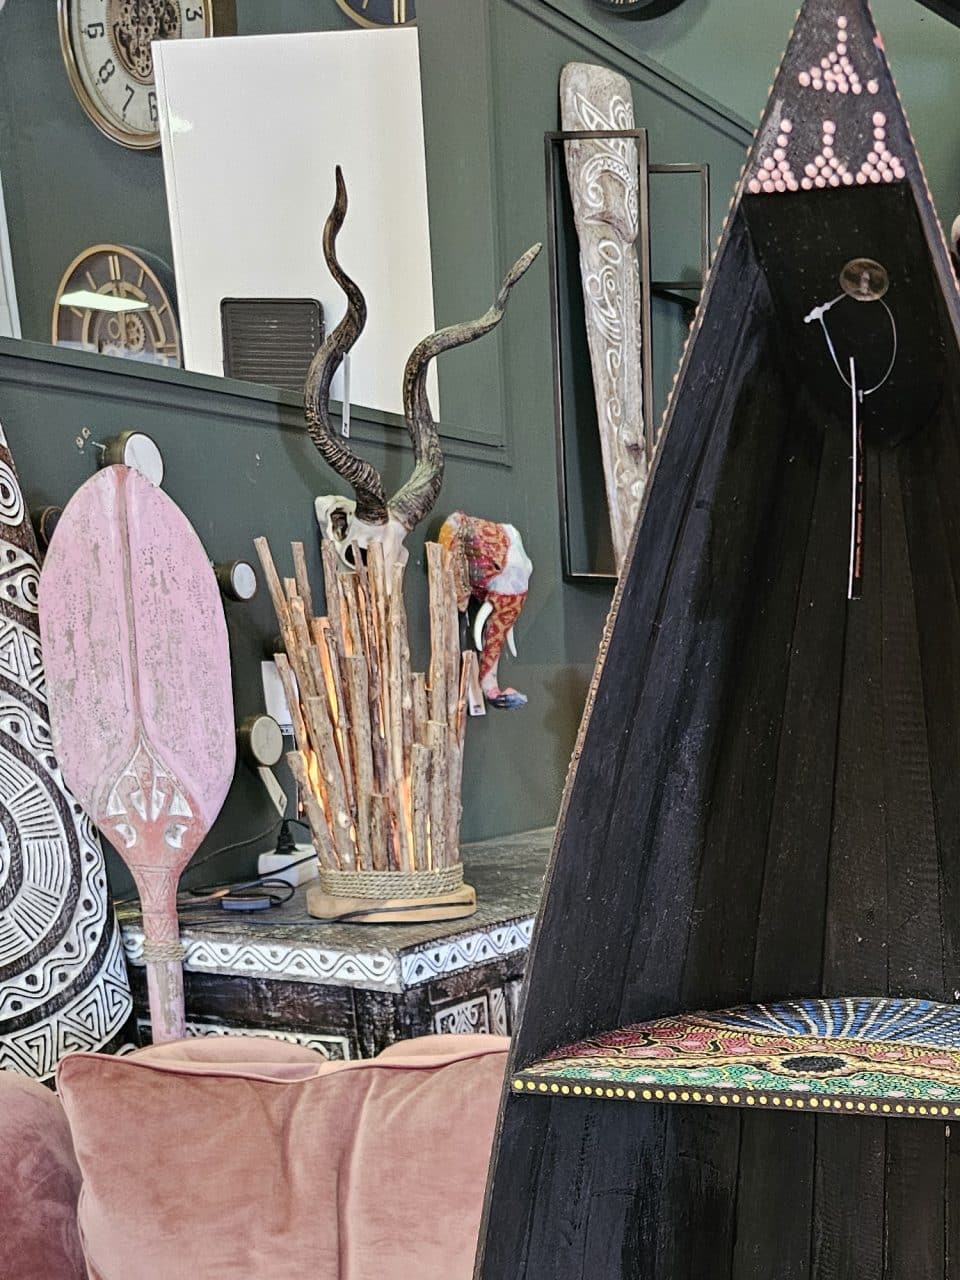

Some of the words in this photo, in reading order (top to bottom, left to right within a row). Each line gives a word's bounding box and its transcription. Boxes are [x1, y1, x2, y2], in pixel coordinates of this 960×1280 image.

[88, 22, 104, 39] 9
[99, 59, 115, 84] 8
[122, 84, 135, 112] 7
